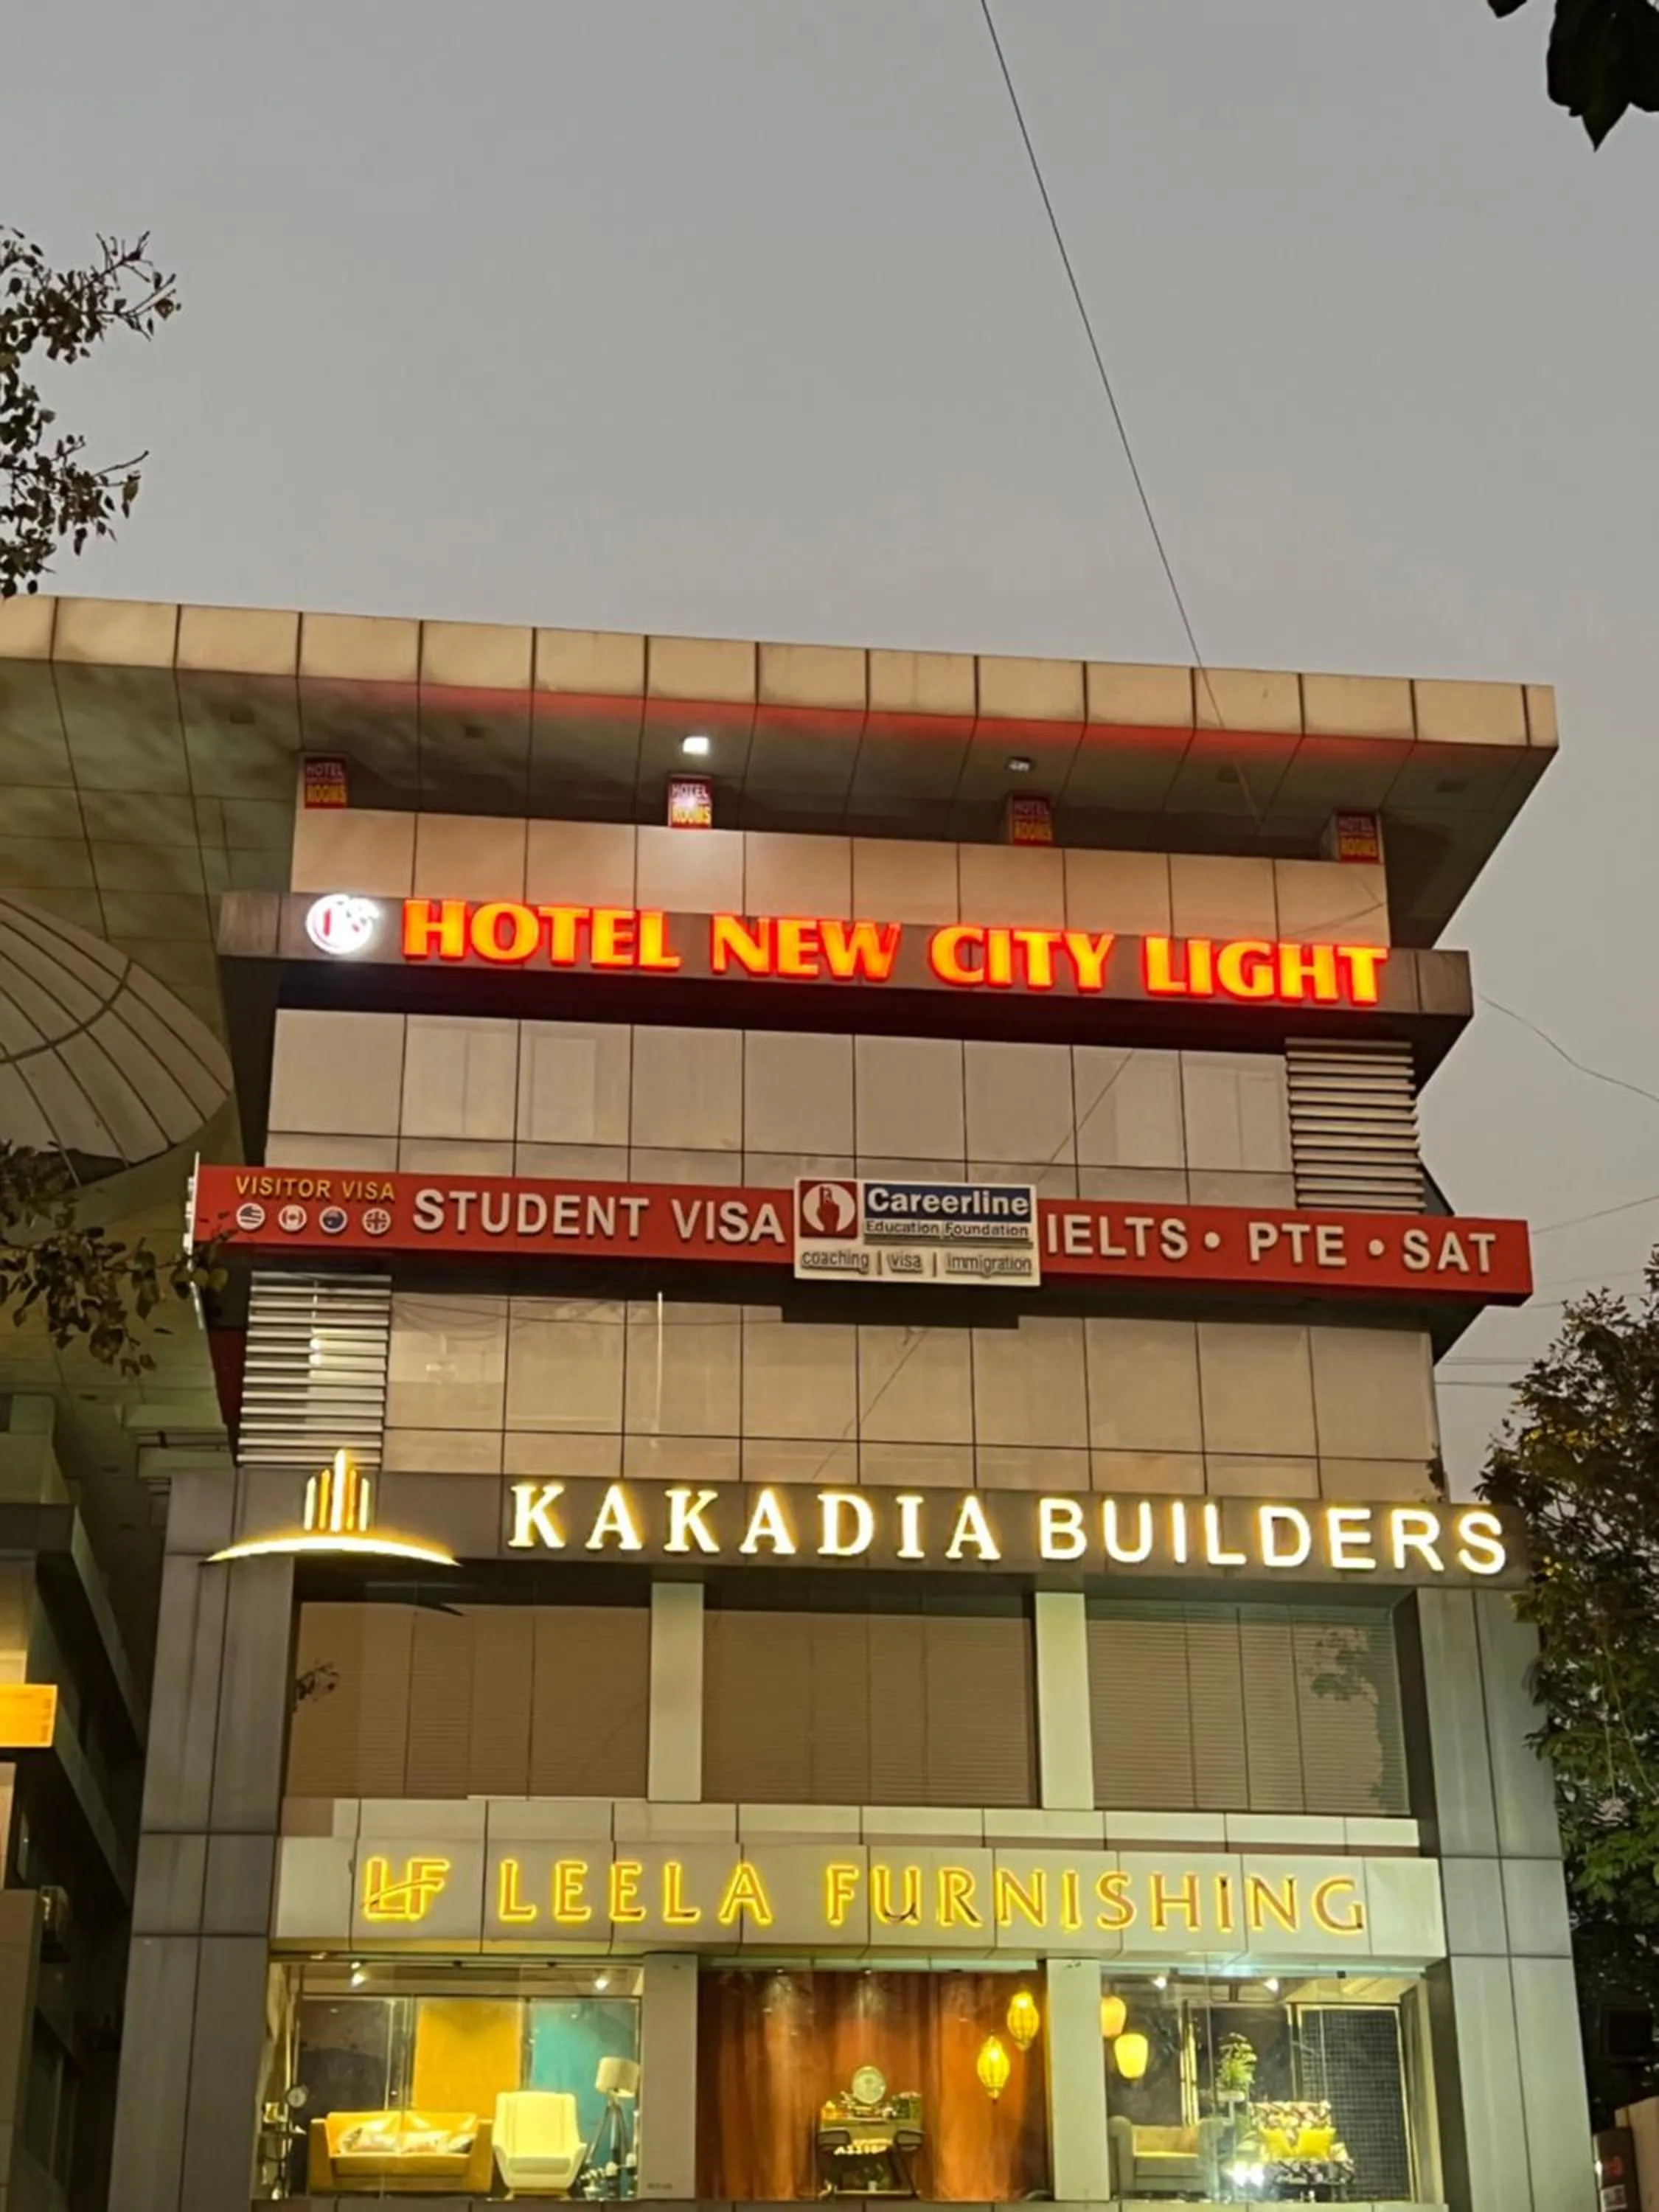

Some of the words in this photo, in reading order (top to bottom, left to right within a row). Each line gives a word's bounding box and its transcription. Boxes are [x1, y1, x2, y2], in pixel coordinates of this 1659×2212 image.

[672, 783, 708, 798] HOTEL
[403, 897, 681, 973] HOTEL
[712, 914, 900, 981] NEW
[931, 924, 1114, 993] CITY
[1143, 936, 1388, 1006] LIGHT
[235, 1175, 331, 1199] VISITOR
[342, 1181, 395, 1202] VISA
[867, 1187, 1030, 1217] Careerline
[413, 1188, 650, 1239] STUDENT
[672, 1200, 786, 1245] VISA
[866, 1220, 939, 1234] Education
[945, 1222, 1029, 1237] Foundation
[801, 1251, 869, 1271] coaching
[889, 1253, 922, 1269] visa
[947, 1255, 1032, 1275] immigration
[1047, 1214, 1189, 1259] IELTS
[1248, 1221, 1347, 1267] PTE
[1404, 1230, 1497, 1273] SAT
[508, 1482, 1002, 1562] KAKADIA
[1038, 1495, 1508, 1576] BUILDERS
[499, 1860, 772, 1925] LEELA
[825, 1865, 1367, 1935] FURNISHING
